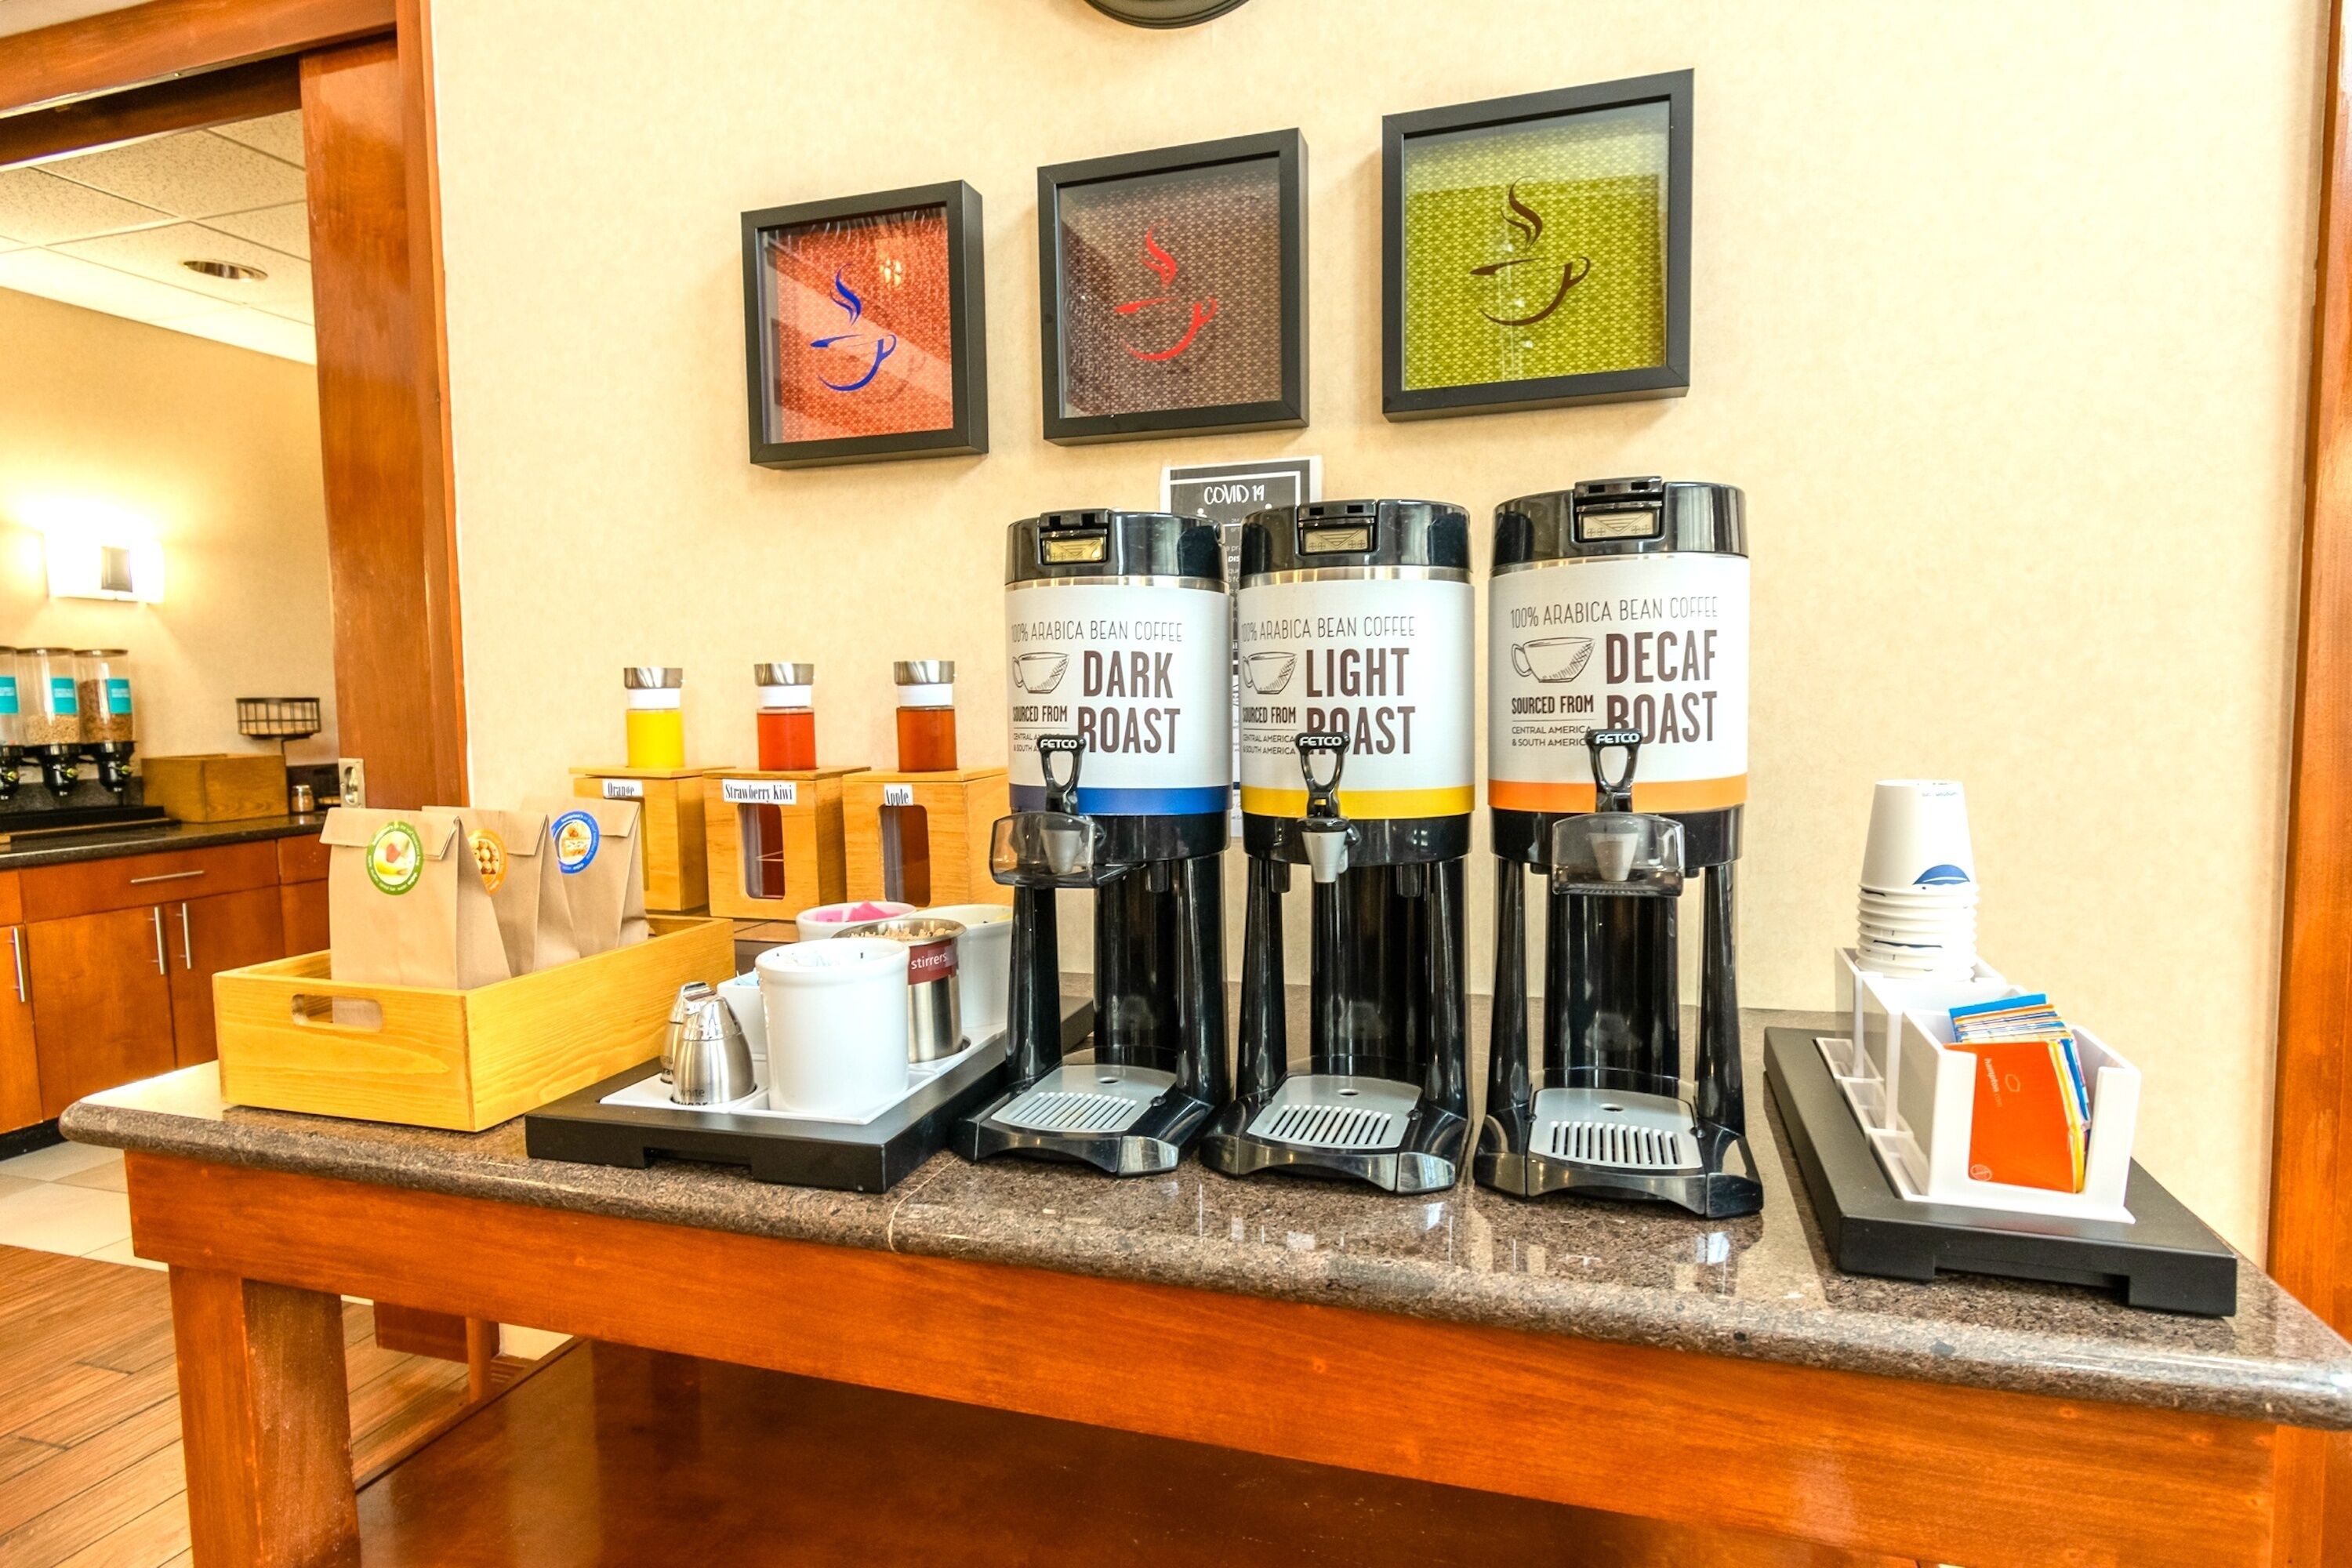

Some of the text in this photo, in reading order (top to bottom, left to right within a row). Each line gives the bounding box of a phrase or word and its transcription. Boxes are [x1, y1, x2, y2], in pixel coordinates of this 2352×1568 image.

[1204, 484, 1265, 505] COVID 19
[1511, 596, 1718, 629] 100% ARABICA BEAN COFFEE
[1011, 620, 1182, 642] 100% ARABICA BEAN COFFEE
[1242, 616, 1415, 642] 100% ARABICA BEAN COFFEE
[1606, 630, 1718, 684] DECAF
[1083, 650, 1173, 699] DARK
[1306, 648, 1410, 698] LIGHT
[1013, 706, 1067, 722] SOURCED FROM
[1512, 695, 1594, 714] SOURCED FROM
[1243, 706, 1296, 723] SOURCED FROM
[1606, 691, 1718, 745] ROAST
[1078, 706, 1181, 754] ROAST
[1512, 725, 1592, 735] CENTRAL AMERICA
[1595, 733, 1640, 744] FETCO
[1040, 739, 1078, 750] FETCO
[1263, 746, 1296, 755] AMERICA
[1299, 736, 1342, 746] FETCO
[725, 784, 793, 803] Strawberry Kiwi
[886, 788, 909, 806] Apple
[910, 953, 947, 970] stirrers
